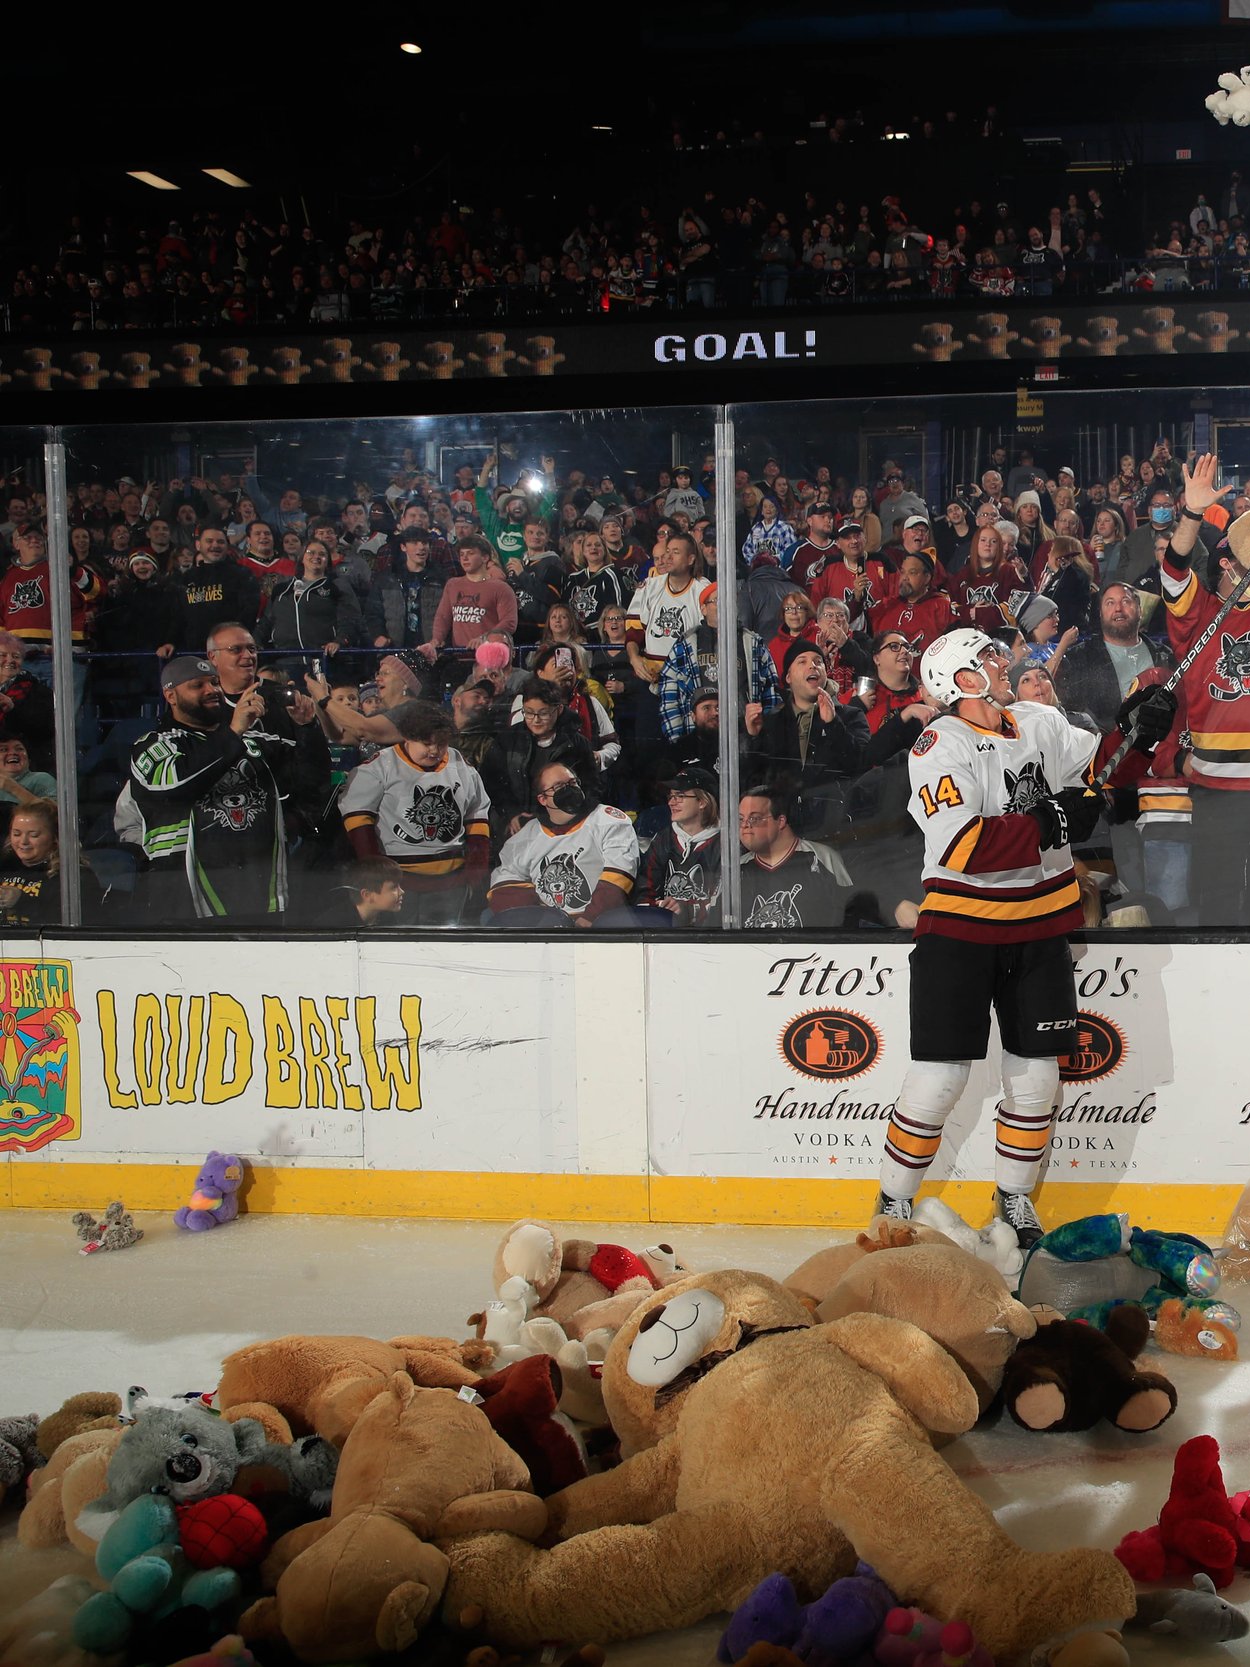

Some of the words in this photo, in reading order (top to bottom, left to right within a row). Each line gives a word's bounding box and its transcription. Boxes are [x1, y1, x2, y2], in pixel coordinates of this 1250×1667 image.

[654, 330, 816, 363] GOAL!
[186, 589, 223, 604] WLVES
[134, 740, 173, 777] 50
[918, 773, 965, 819] 14
[9, 968, 64, 1009] BREW
[767, 952, 893, 997] Tito's
[1073, 956, 1138, 998] o's
[1035, 1018, 1077, 1032] CCM
[96, 989, 254, 1109] LOUD
[262, 994, 422, 1112] BREW
[753, 1088, 900, 1122] Handmad
[1049, 1091, 1157, 1124] dmade
[793, 1132, 873, 1147] VODKA
[1051, 1136, 1115, 1151] ODKA
[772, 1155, 821, 1164] AUSTIN
[848, 1156, 884, 1165] TEXA
[1089, 1160, 1139, 1169] TEXAS
